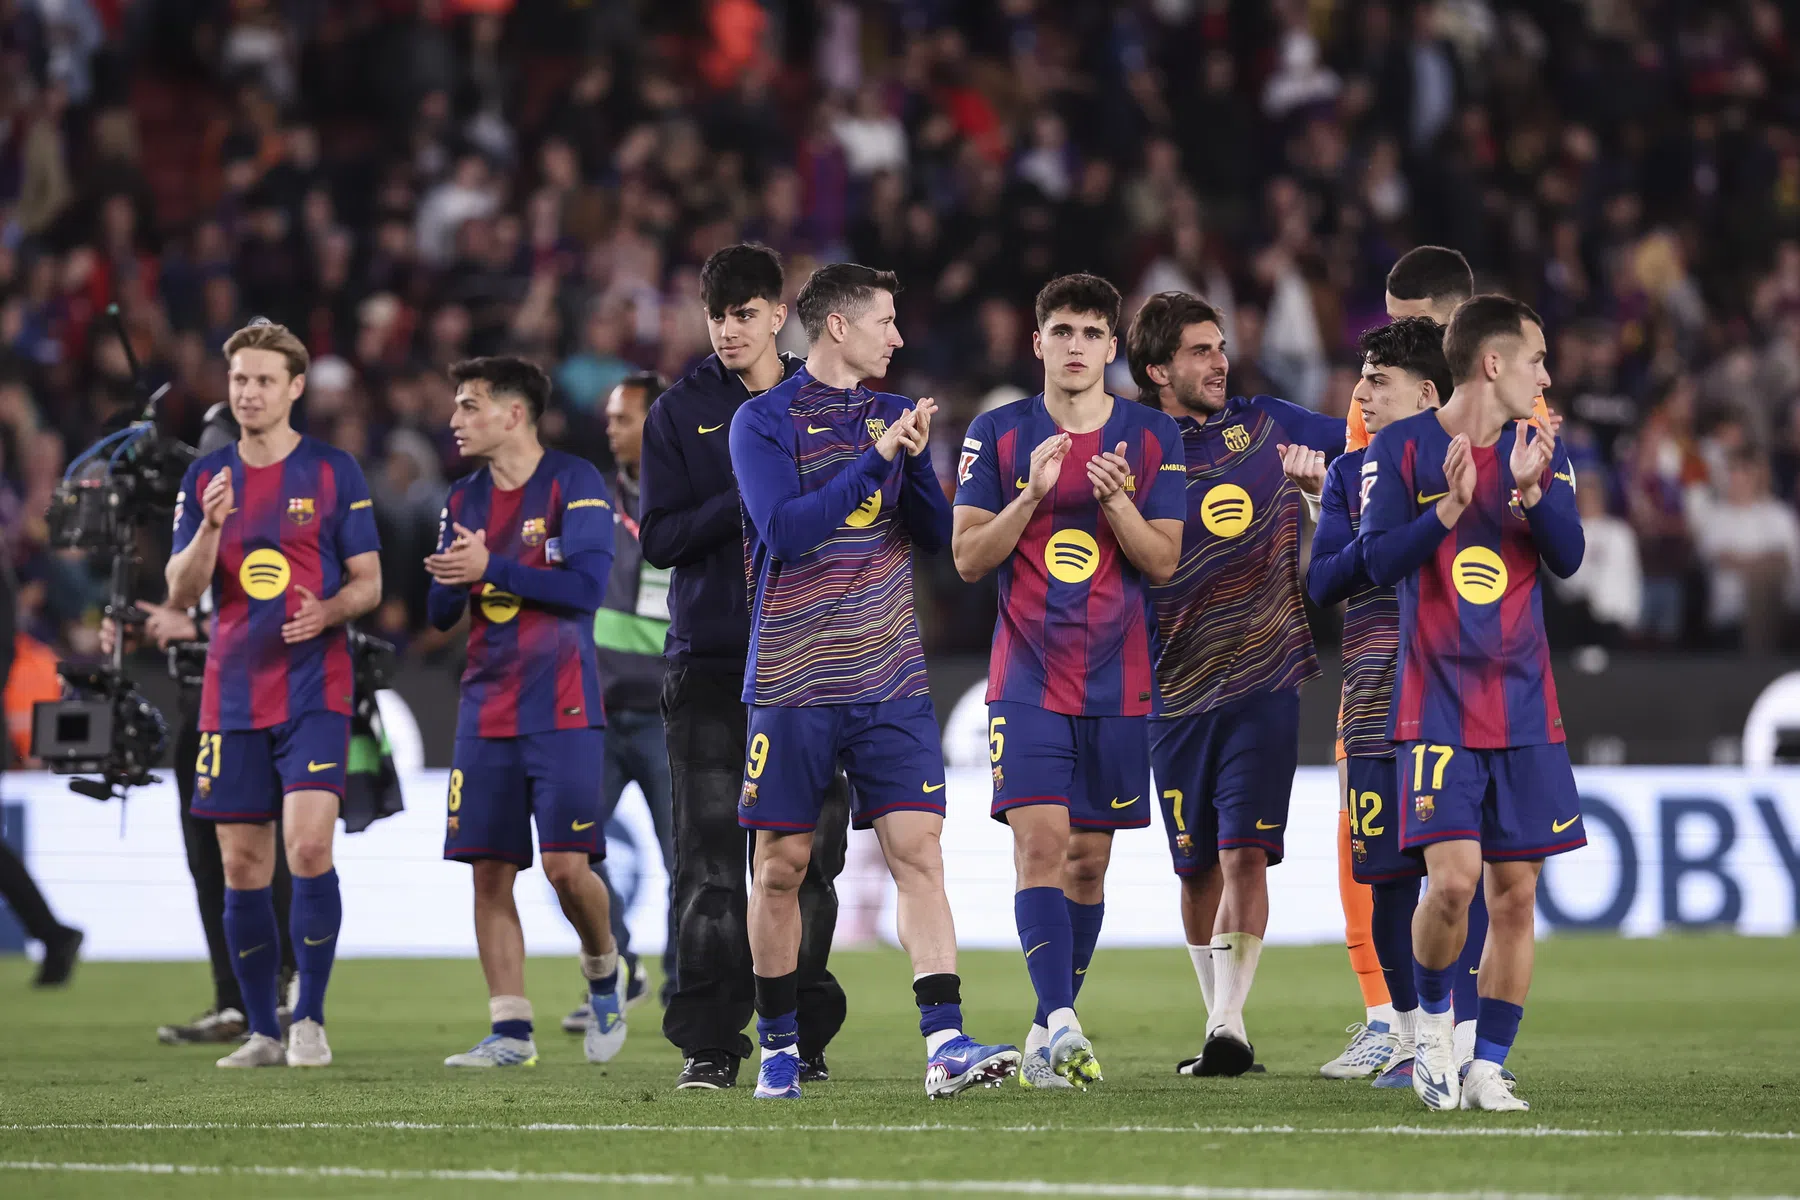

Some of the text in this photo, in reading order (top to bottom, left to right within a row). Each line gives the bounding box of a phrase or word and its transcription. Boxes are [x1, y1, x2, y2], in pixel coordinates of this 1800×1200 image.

[196, 731, 222, 778] 21
[747, 733, 770, 779] 9
[989, 716, 1007, 763] 5
[449, 768, 464, 812] 8
[1411, 744, 1454, 791] 17
[1163, 788, 1186, 831] 7
[1350, 788, 1384, 836] 42
